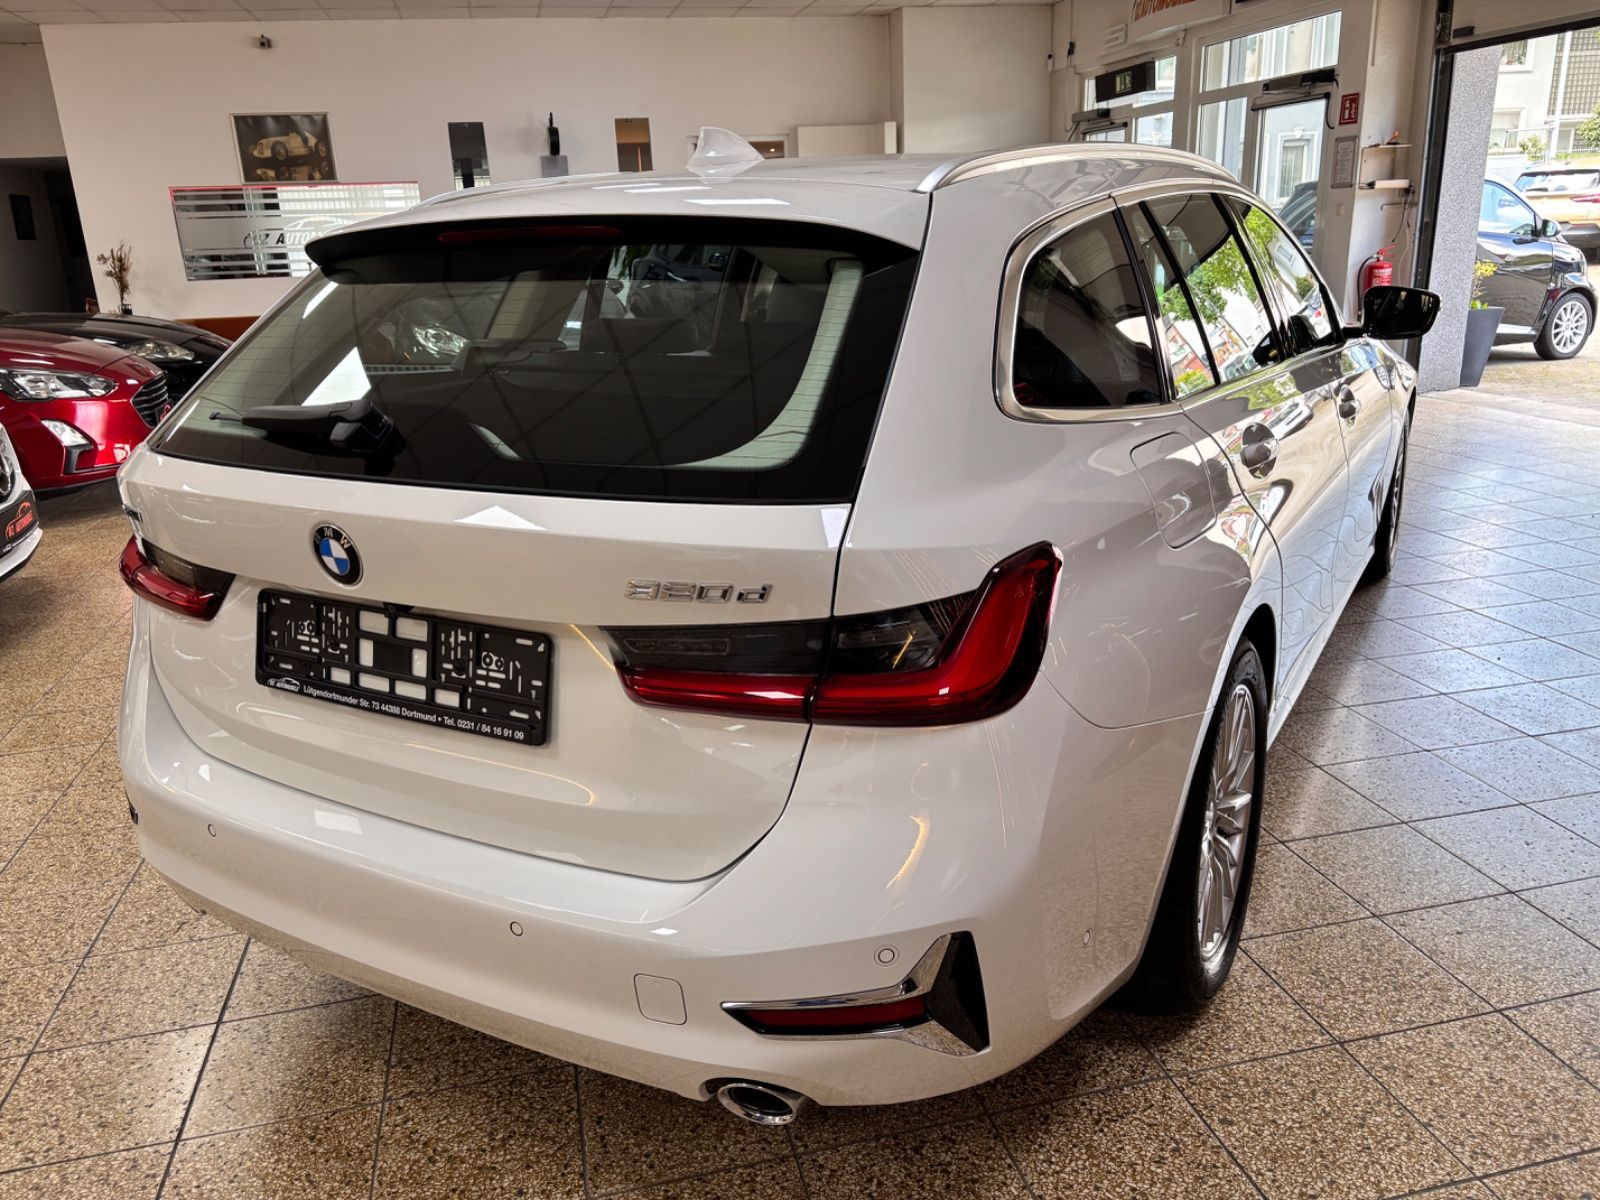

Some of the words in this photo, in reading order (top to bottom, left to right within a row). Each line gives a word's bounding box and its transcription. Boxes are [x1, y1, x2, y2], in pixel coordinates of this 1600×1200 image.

[314, 527, 352, 549] BMW
[303, 685, 358, 705] Lütgendortmunder
[359, 698, 371, 709] Str.
[371, 700, 380, 710] 73
[380, 703, 400, 715] 44388
[401, 707, 437, 721] Dortmund
[443, 716, 456, 727] Tel.
[457, 719, 475, 730] 0231
[481, 724, 491, 734] 84
[493, 726, 502, 736] 16
[503, 728, 512, 738] 91
[513, 730, 524, 740] 09
